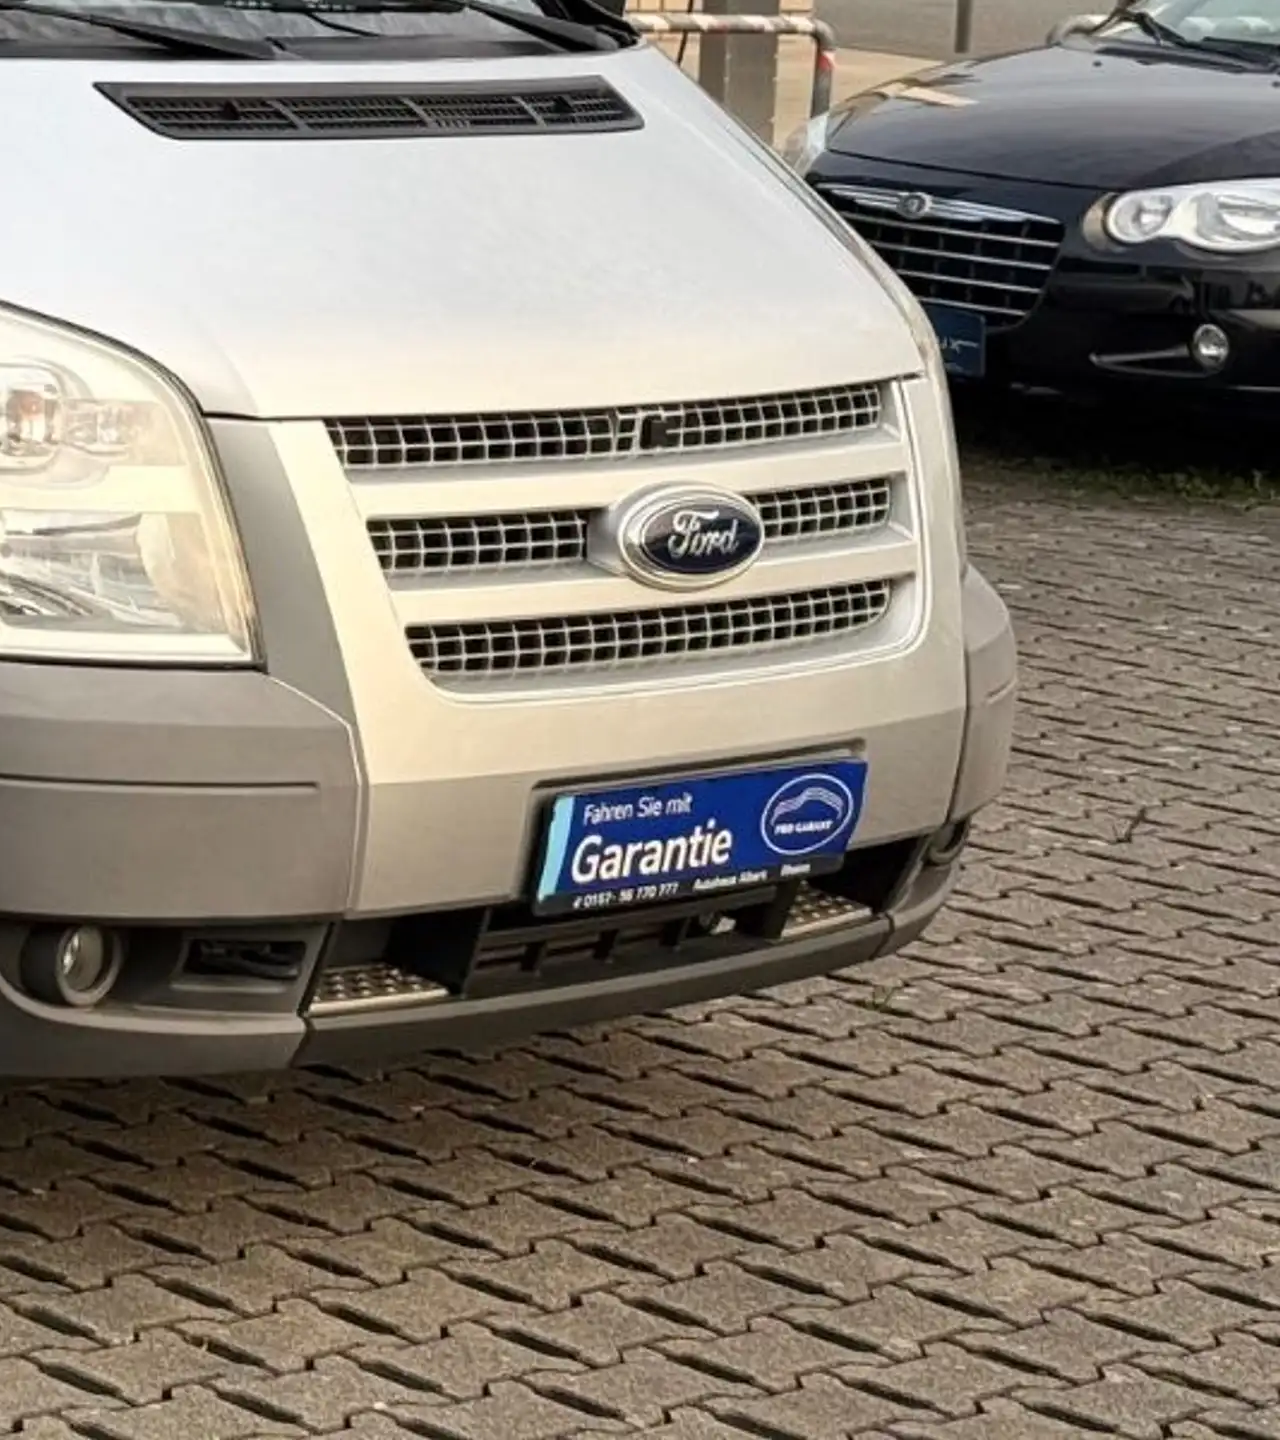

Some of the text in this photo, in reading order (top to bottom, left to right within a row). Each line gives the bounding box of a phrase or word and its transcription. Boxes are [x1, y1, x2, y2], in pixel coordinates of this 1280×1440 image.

[668, 510, 739, 559] Ford
[583, 791, 693, 826] Fahren Sie mit
[571, 817, 733, 883] Garantie
